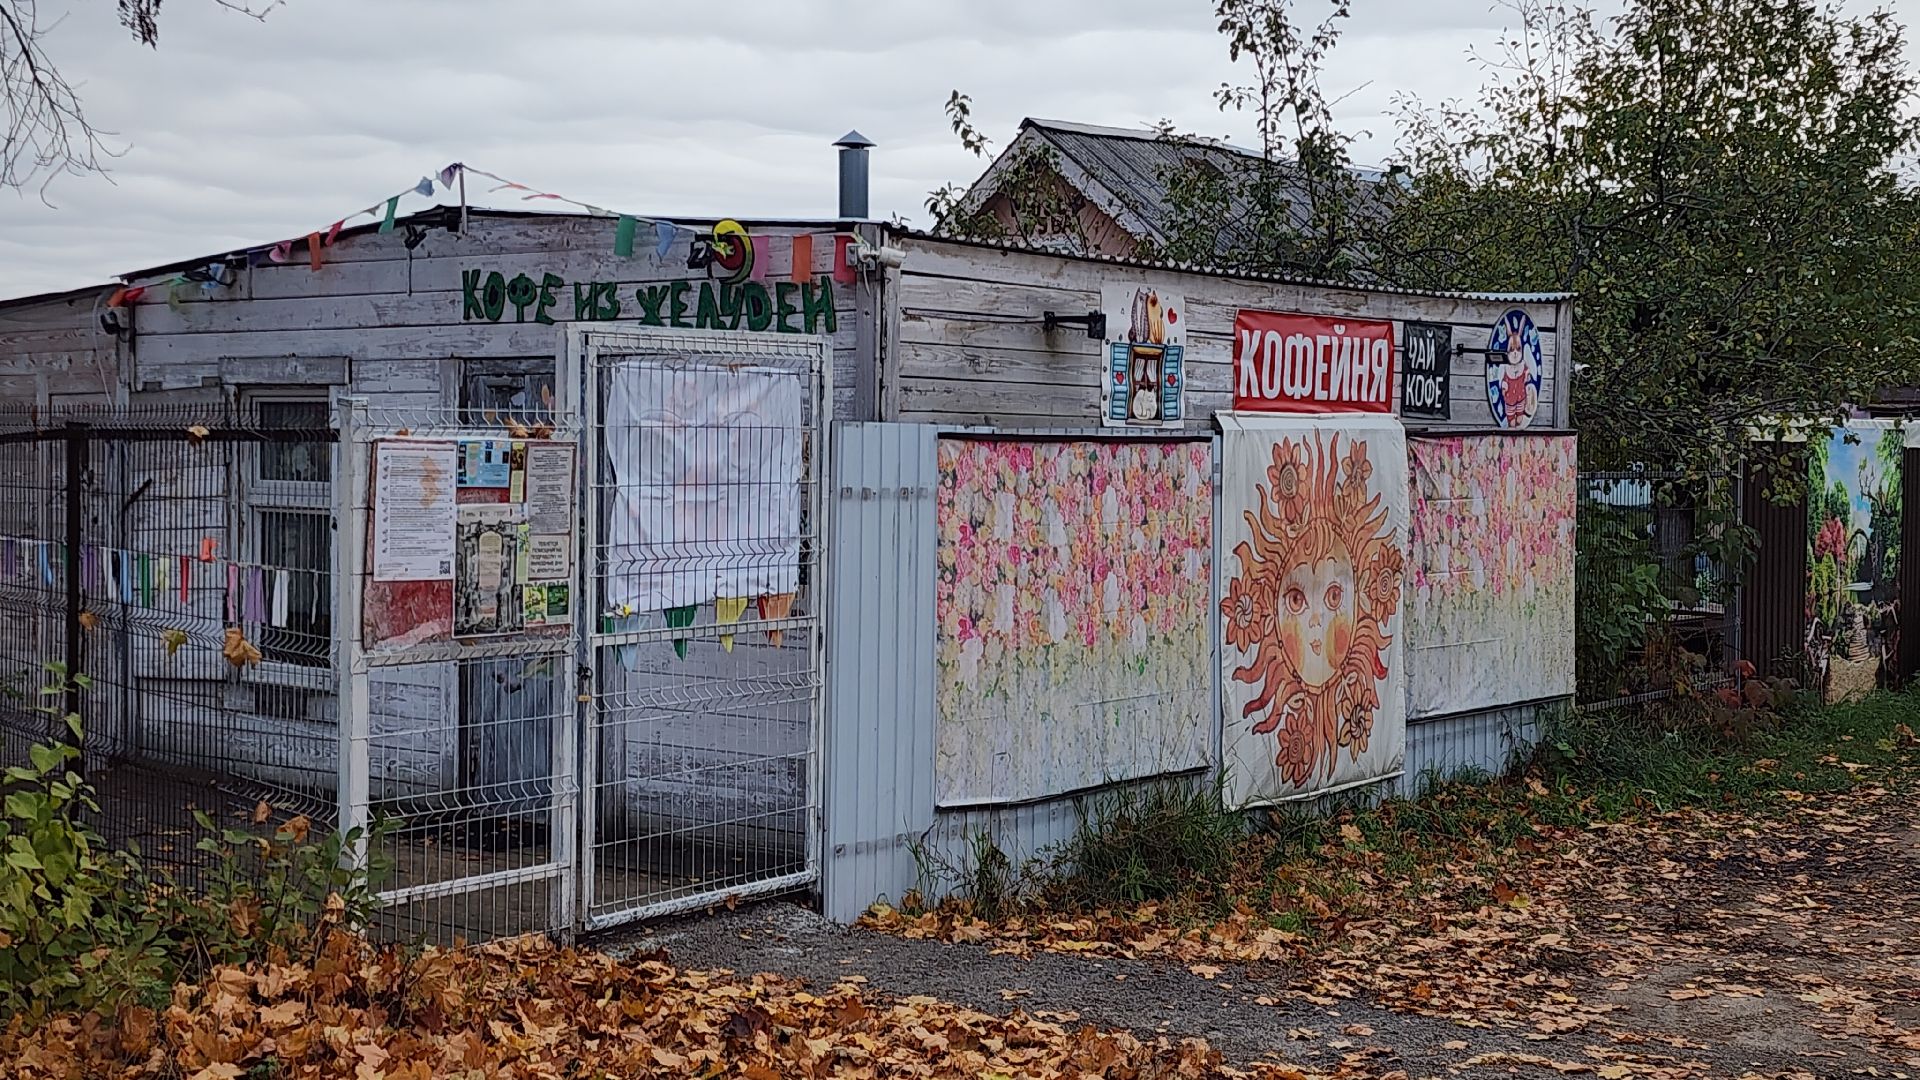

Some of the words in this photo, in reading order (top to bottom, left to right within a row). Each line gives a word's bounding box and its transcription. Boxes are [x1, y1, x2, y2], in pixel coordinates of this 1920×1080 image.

[462, 269, 564, 325] КОФЕ
[574, 281, 621, 321] ИЗ
[1239, 324, 1389, 402] КОФЕЙНЯ
[1408, 330, 1436, 371] ЧАЙ
[1405, 373, 1444, 408] КОФЕ
